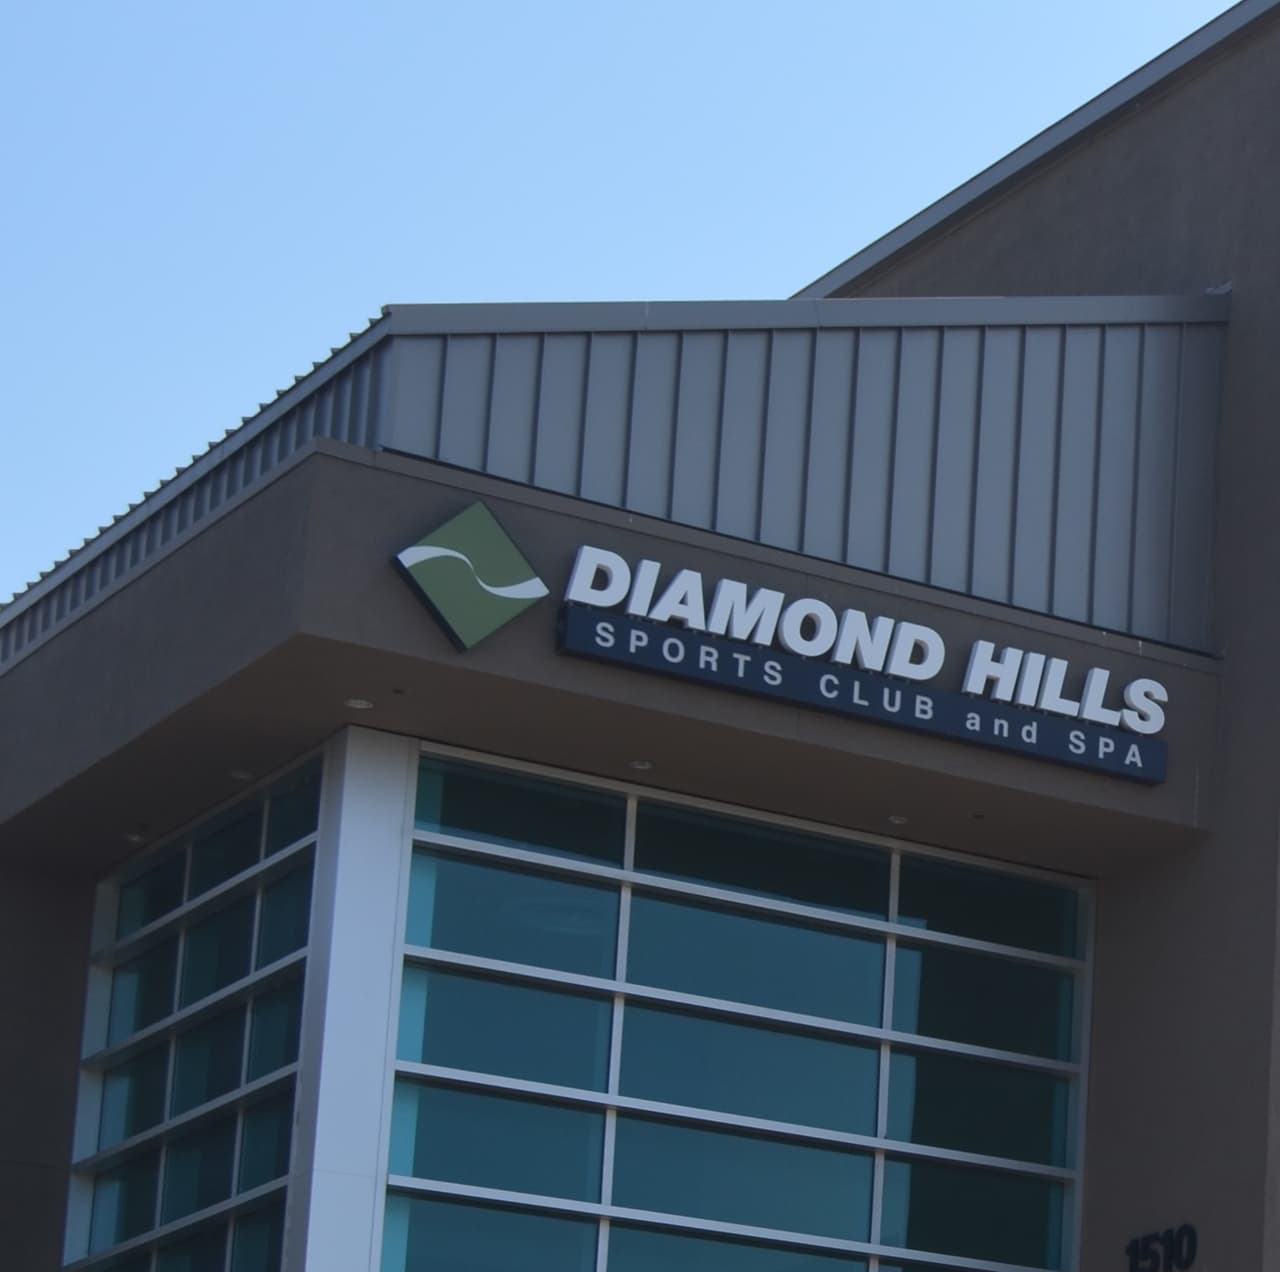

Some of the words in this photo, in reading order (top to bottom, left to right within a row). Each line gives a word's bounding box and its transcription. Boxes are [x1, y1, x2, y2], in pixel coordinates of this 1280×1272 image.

[566, 544, 946, 683] DIAMOND
[963, 639, 1169, 736] HILLS
[594, 621, 783, 686] SPORTS
[818, 674, 935, 720] CLUB
[964, 709, 1038, 746] and
[1067, 730, 1145, 769] SPA
